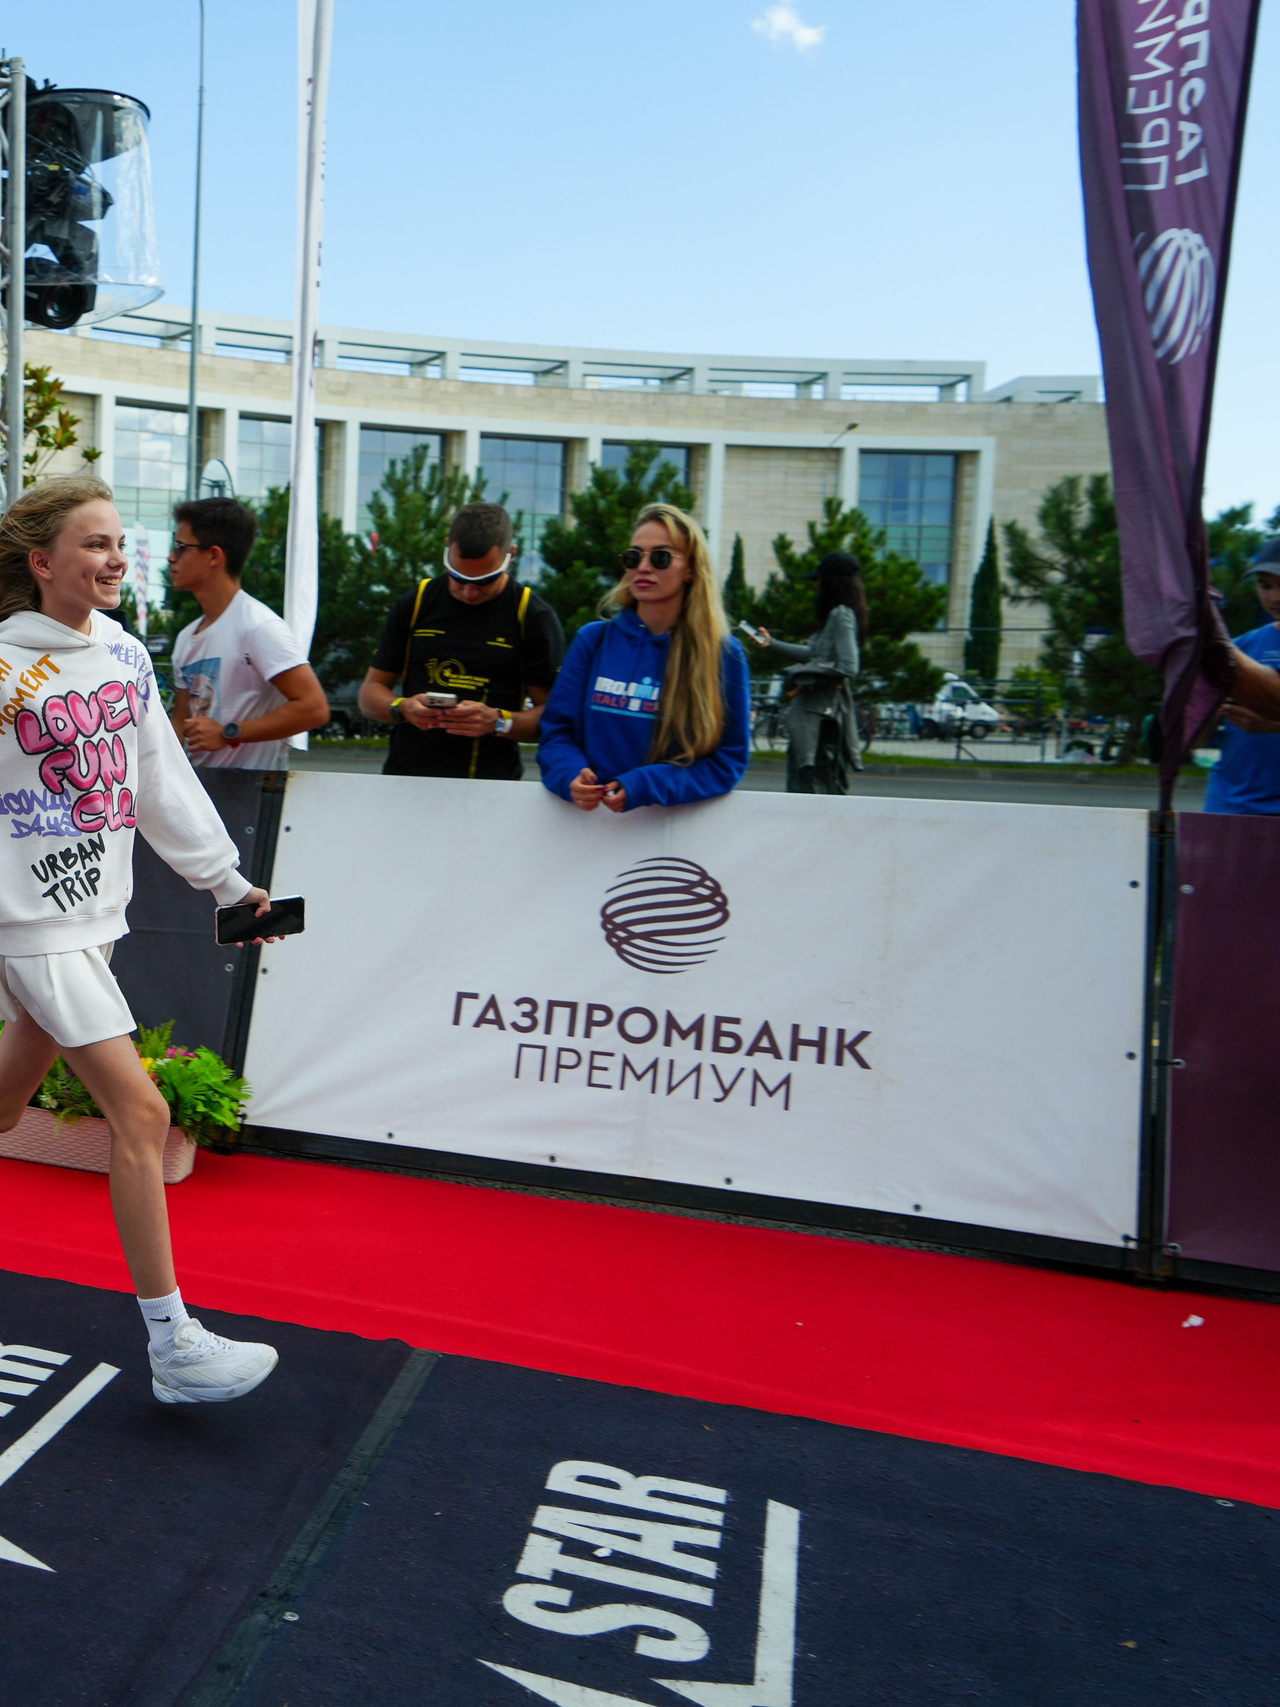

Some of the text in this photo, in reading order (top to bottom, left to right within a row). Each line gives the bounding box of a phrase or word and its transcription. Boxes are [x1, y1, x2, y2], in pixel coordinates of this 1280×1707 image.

[38, 733, 128, 795] FUN
[31, 832, 106, 883] URBAN
[452, 991, 873, 1070] ГАЗПРОМБАНК
[514, 1043, 793, 1111] ПРЕМИУМ
[502, 1459, 727, 1663] STAR
